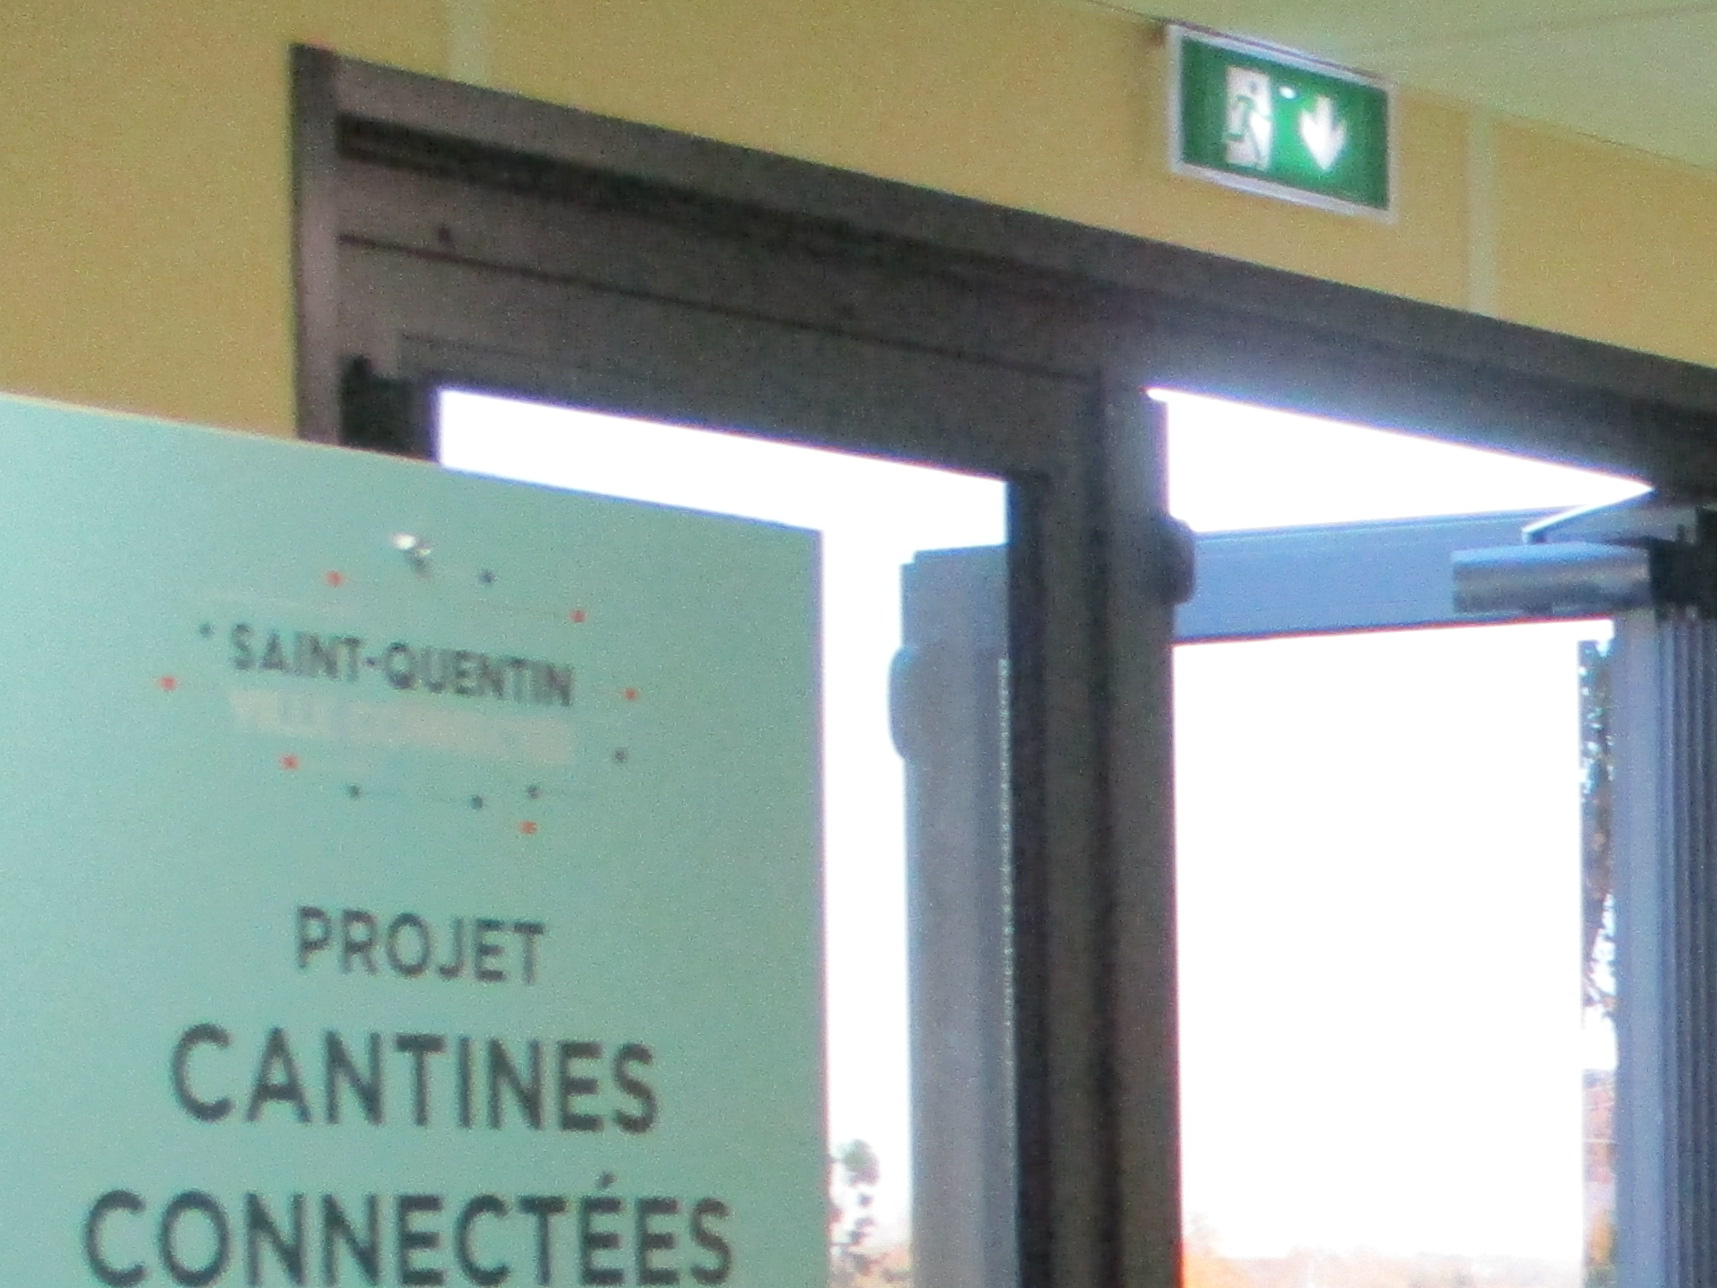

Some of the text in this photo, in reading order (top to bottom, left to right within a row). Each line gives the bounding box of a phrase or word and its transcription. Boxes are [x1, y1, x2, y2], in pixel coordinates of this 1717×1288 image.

[231, 622, 576, 707] SAINT-QUENTIN
[295, 905, 547, 986] PROJET
[170, 1023, 659, 1134] CANTINES
